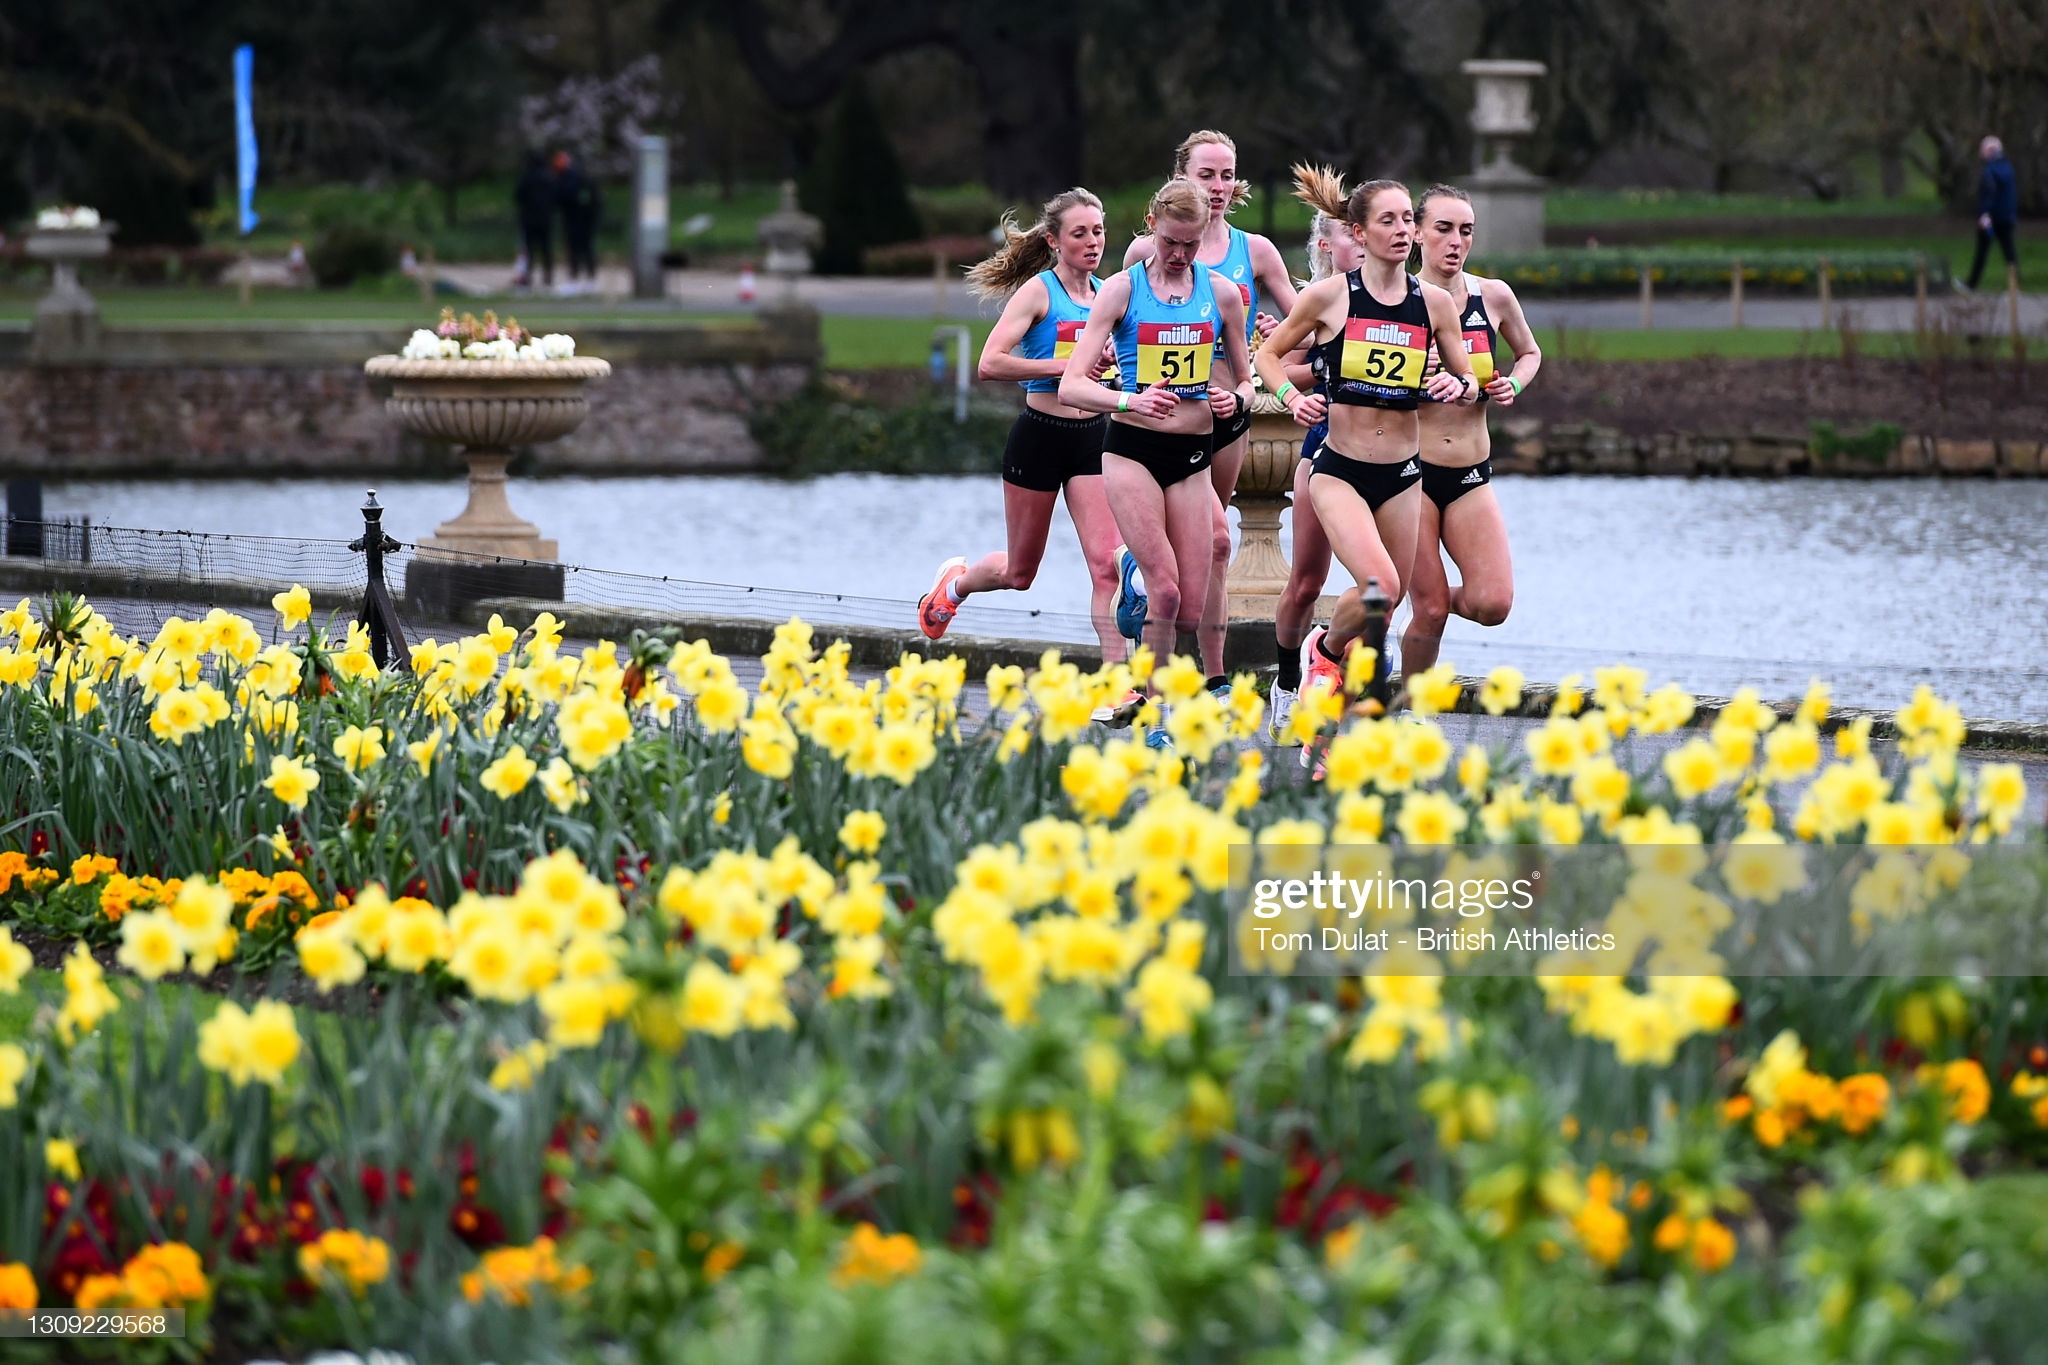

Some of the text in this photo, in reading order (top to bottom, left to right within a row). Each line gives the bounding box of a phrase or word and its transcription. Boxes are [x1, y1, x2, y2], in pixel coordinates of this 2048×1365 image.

[1157, 325, 1203, 345] müller
[1365, 323, 1412, 346] müller
[1160, 350, 1195, 380] 51
[1365, 348, 1407, 382] 52
[1346, 380, 1376, 393] BRITISH
